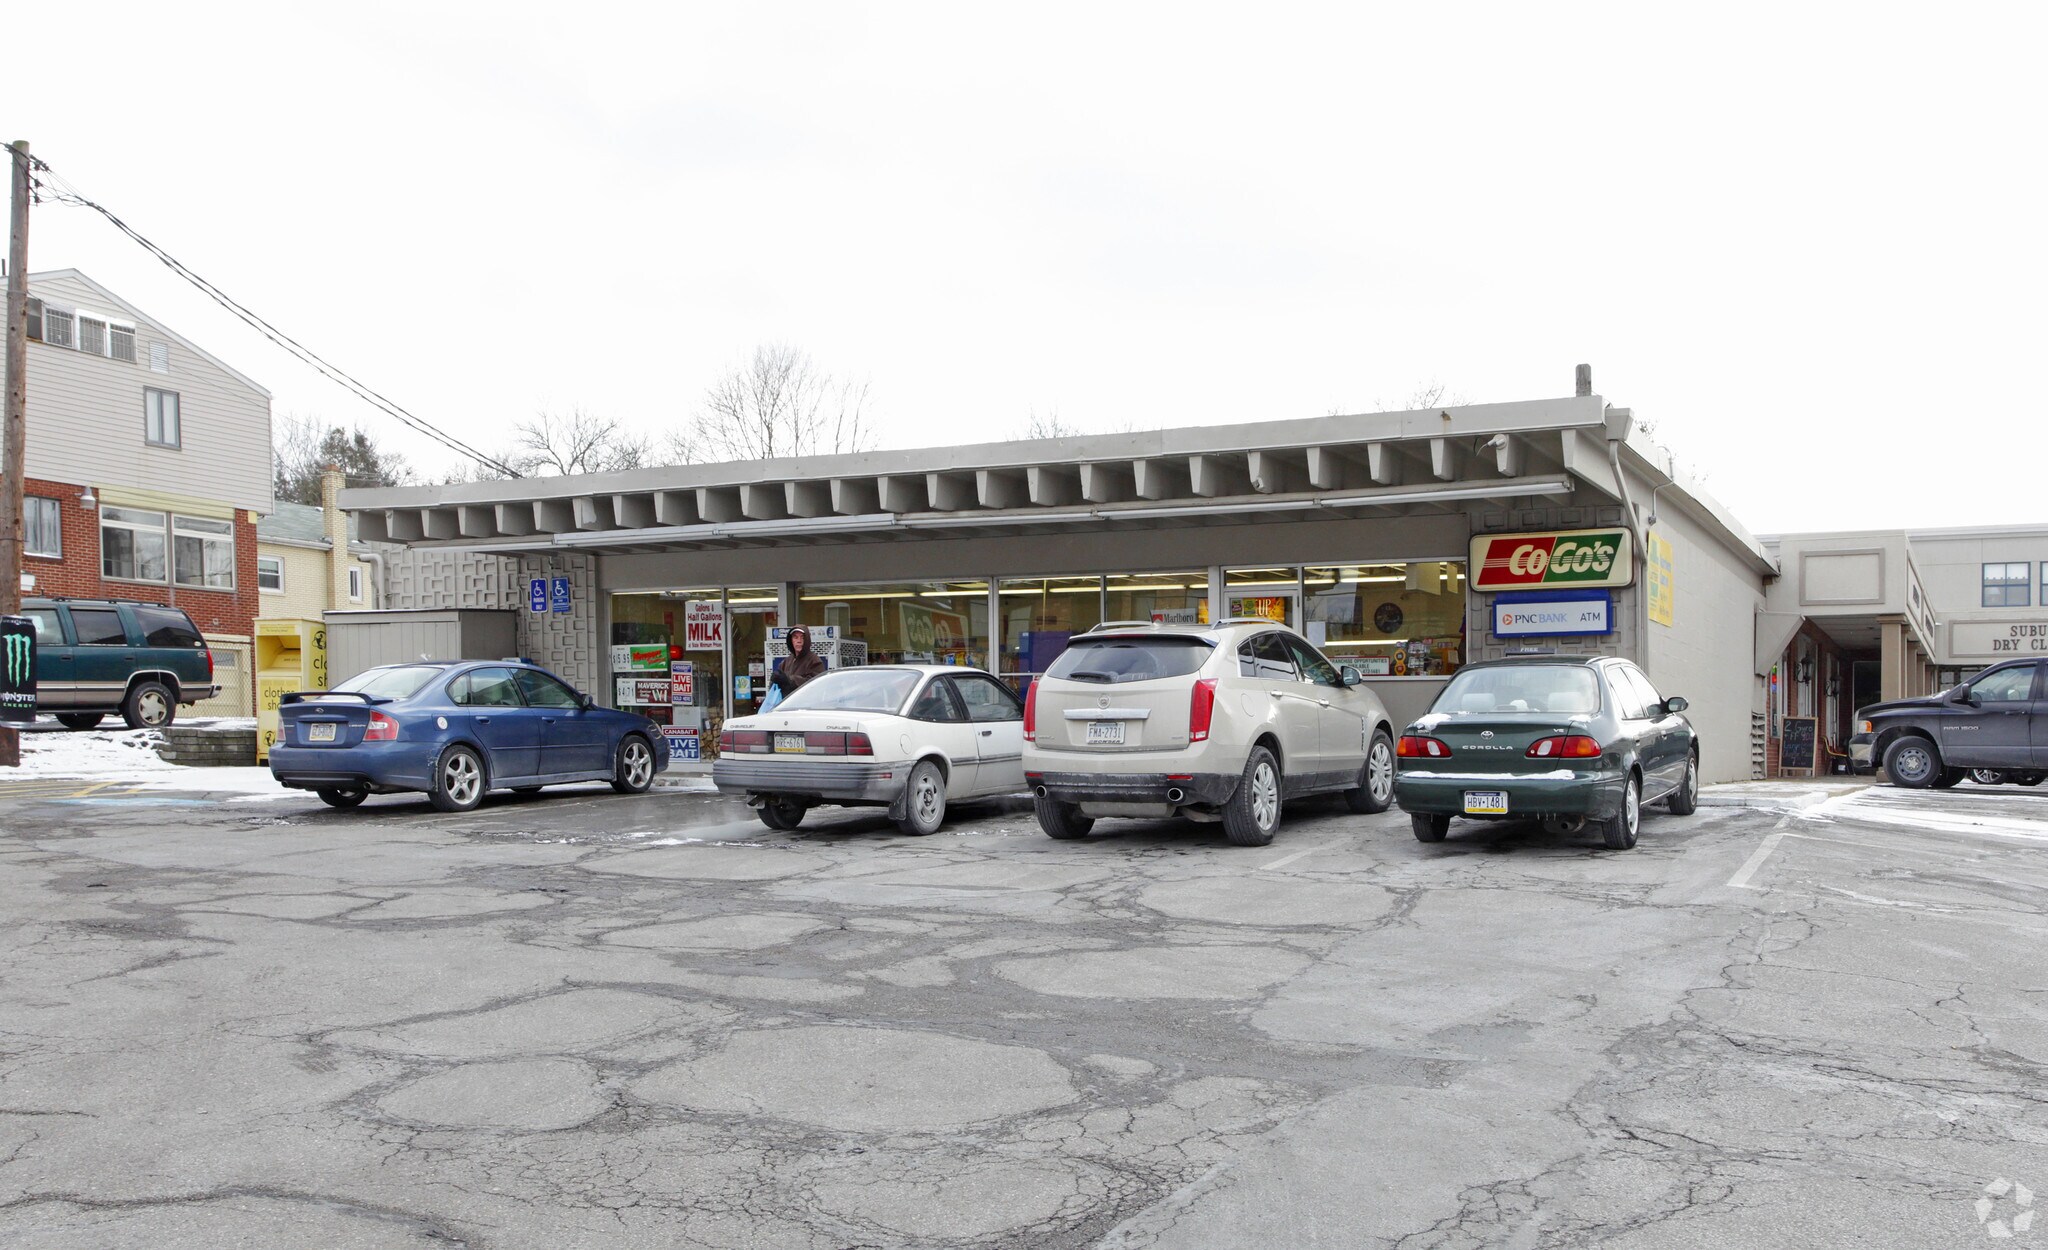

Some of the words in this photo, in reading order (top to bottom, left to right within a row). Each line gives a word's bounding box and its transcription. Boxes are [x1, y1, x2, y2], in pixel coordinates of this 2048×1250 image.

[1255, 599, 1272, 616] UP
[687, 612, 700, 621] Half
[700, 612, 723, 622] Gallons
[1163, 613, 1194, 624] Marlboro
[1514, 613, 1537, 624] PNC
[1538, 612, 1568, 623] BANK
[1579, 611, 1601, 622] ATM
[687, 622, 722, 641] MILK
[1992, 639, 2021, 651] DRY
[673, 675, 691, 683] LIVE
[637, 682, 670, 690] MAVERICK
[673, 684, 691, 692] BAIT
[1784, 720, 1792, 732] 2
[668, 739, 696, 748] LIVE
[669, 748, 698, 758] BAIT
